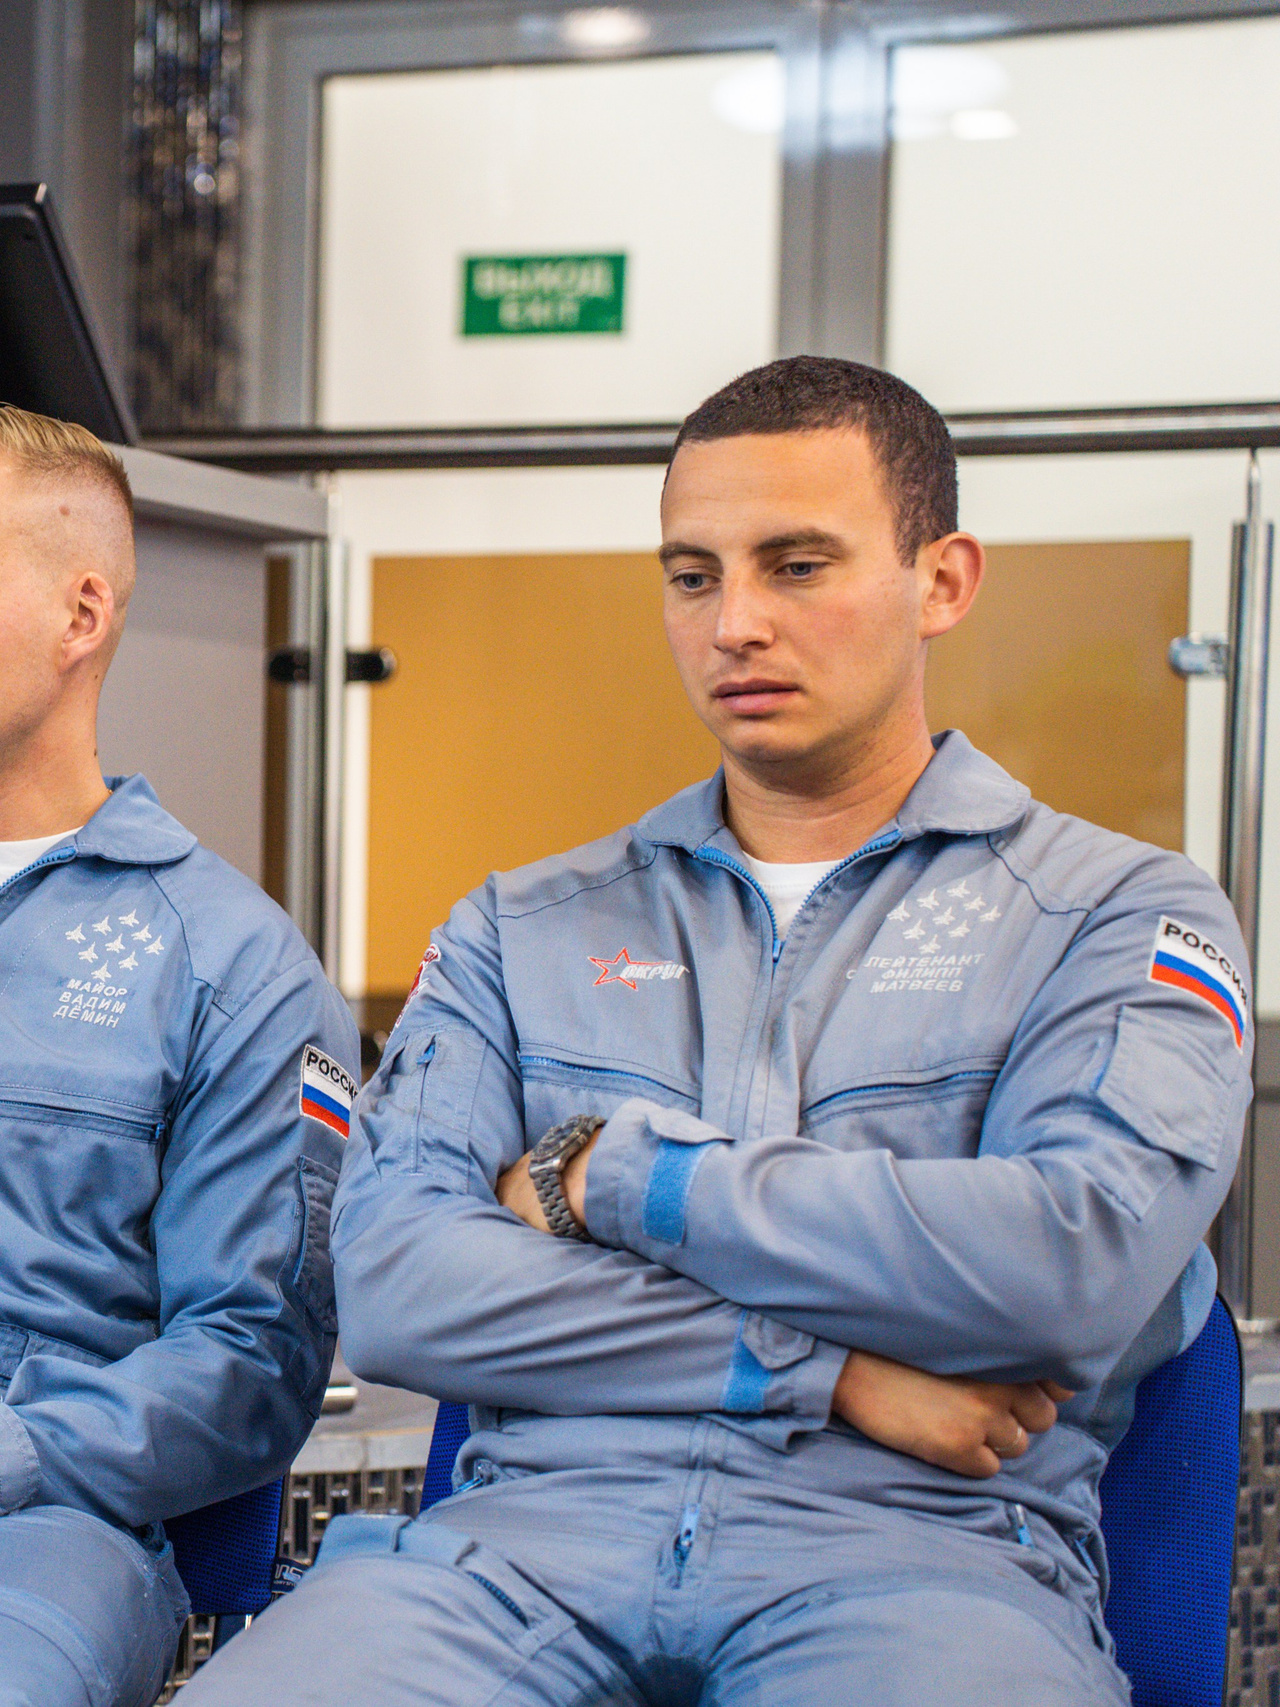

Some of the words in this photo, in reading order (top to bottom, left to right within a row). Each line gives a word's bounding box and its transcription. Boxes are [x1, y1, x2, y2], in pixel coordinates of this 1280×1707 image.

[472, 261, 614, 298] ВЫХОД
[497, 296, 580, 329] EXIT
[863, 953, 986, 969] ЛЕЙТЕНАНТ
[1163, 922, 1248, 1006] РОССИЯ
[881, 966, 963, 980] ФИЛИПП
[66, 978, 128, 998] МАЙОР
[869, 979, 964, 994] МАТВЕЕВ
[58, 991, 127, 1015] ВАДИМ
